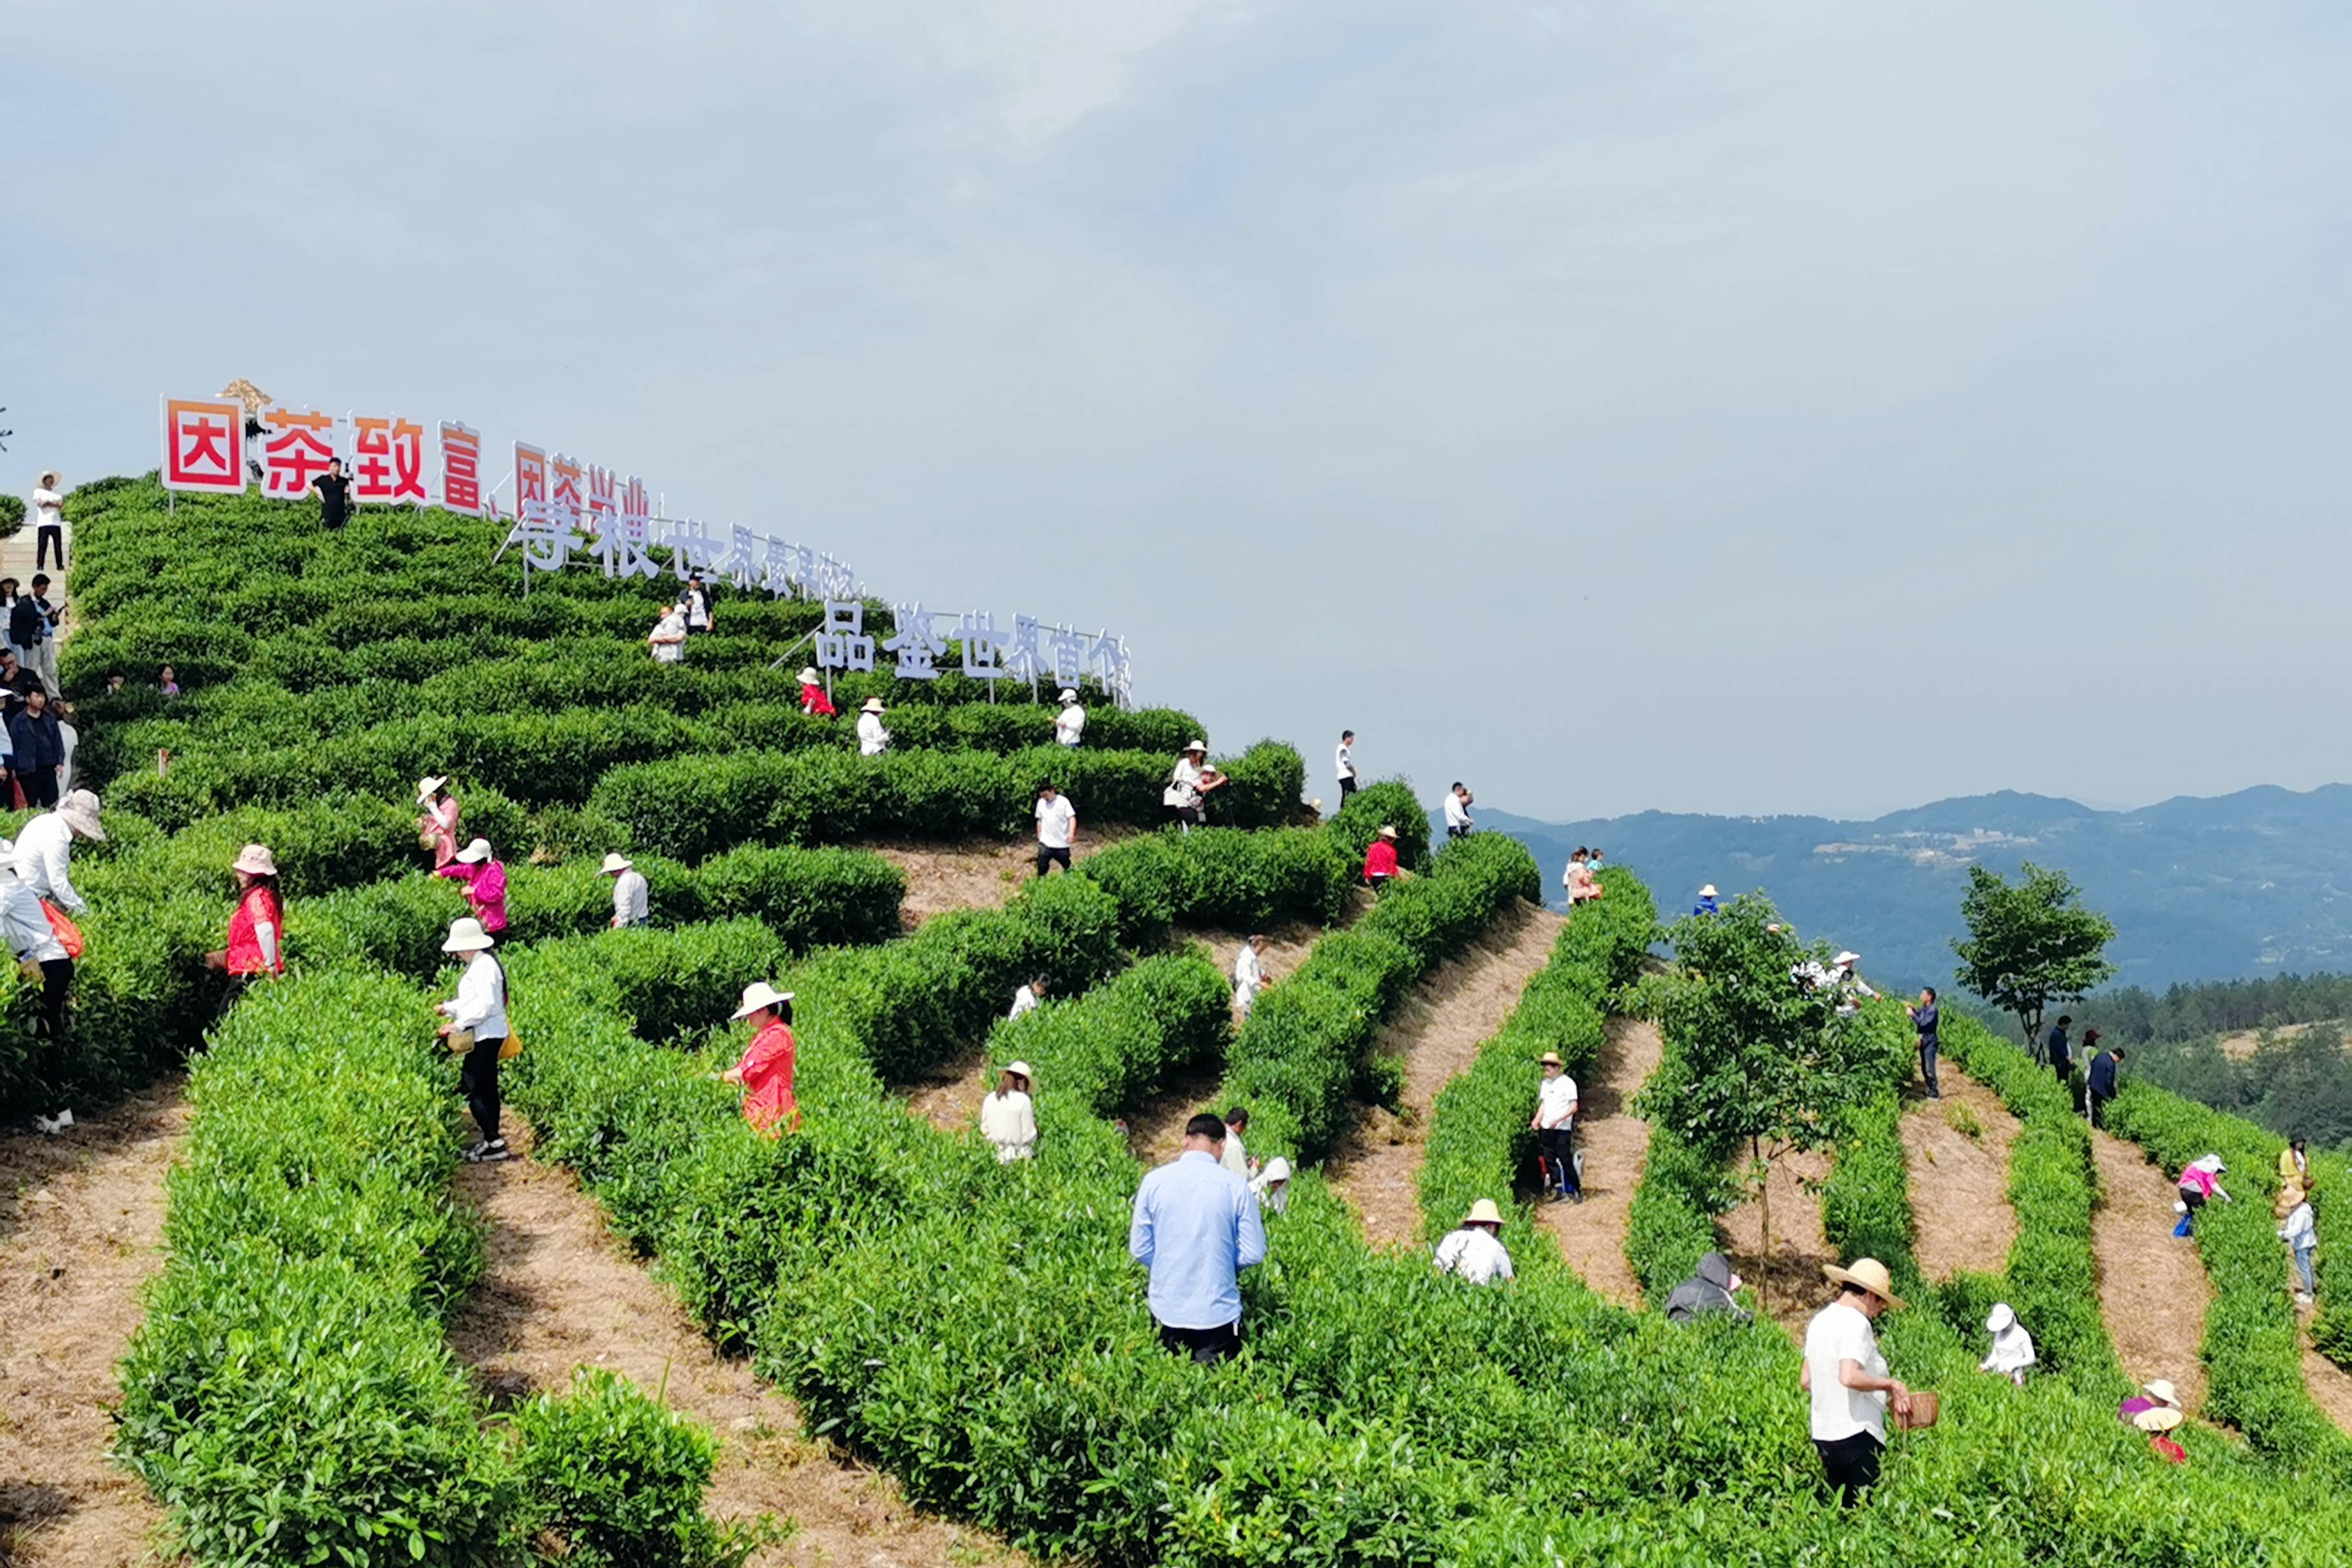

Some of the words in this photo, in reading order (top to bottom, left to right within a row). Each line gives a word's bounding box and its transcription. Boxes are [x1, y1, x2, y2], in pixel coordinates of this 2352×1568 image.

[816, 598, 1133, 709] 品鉴世界首个
